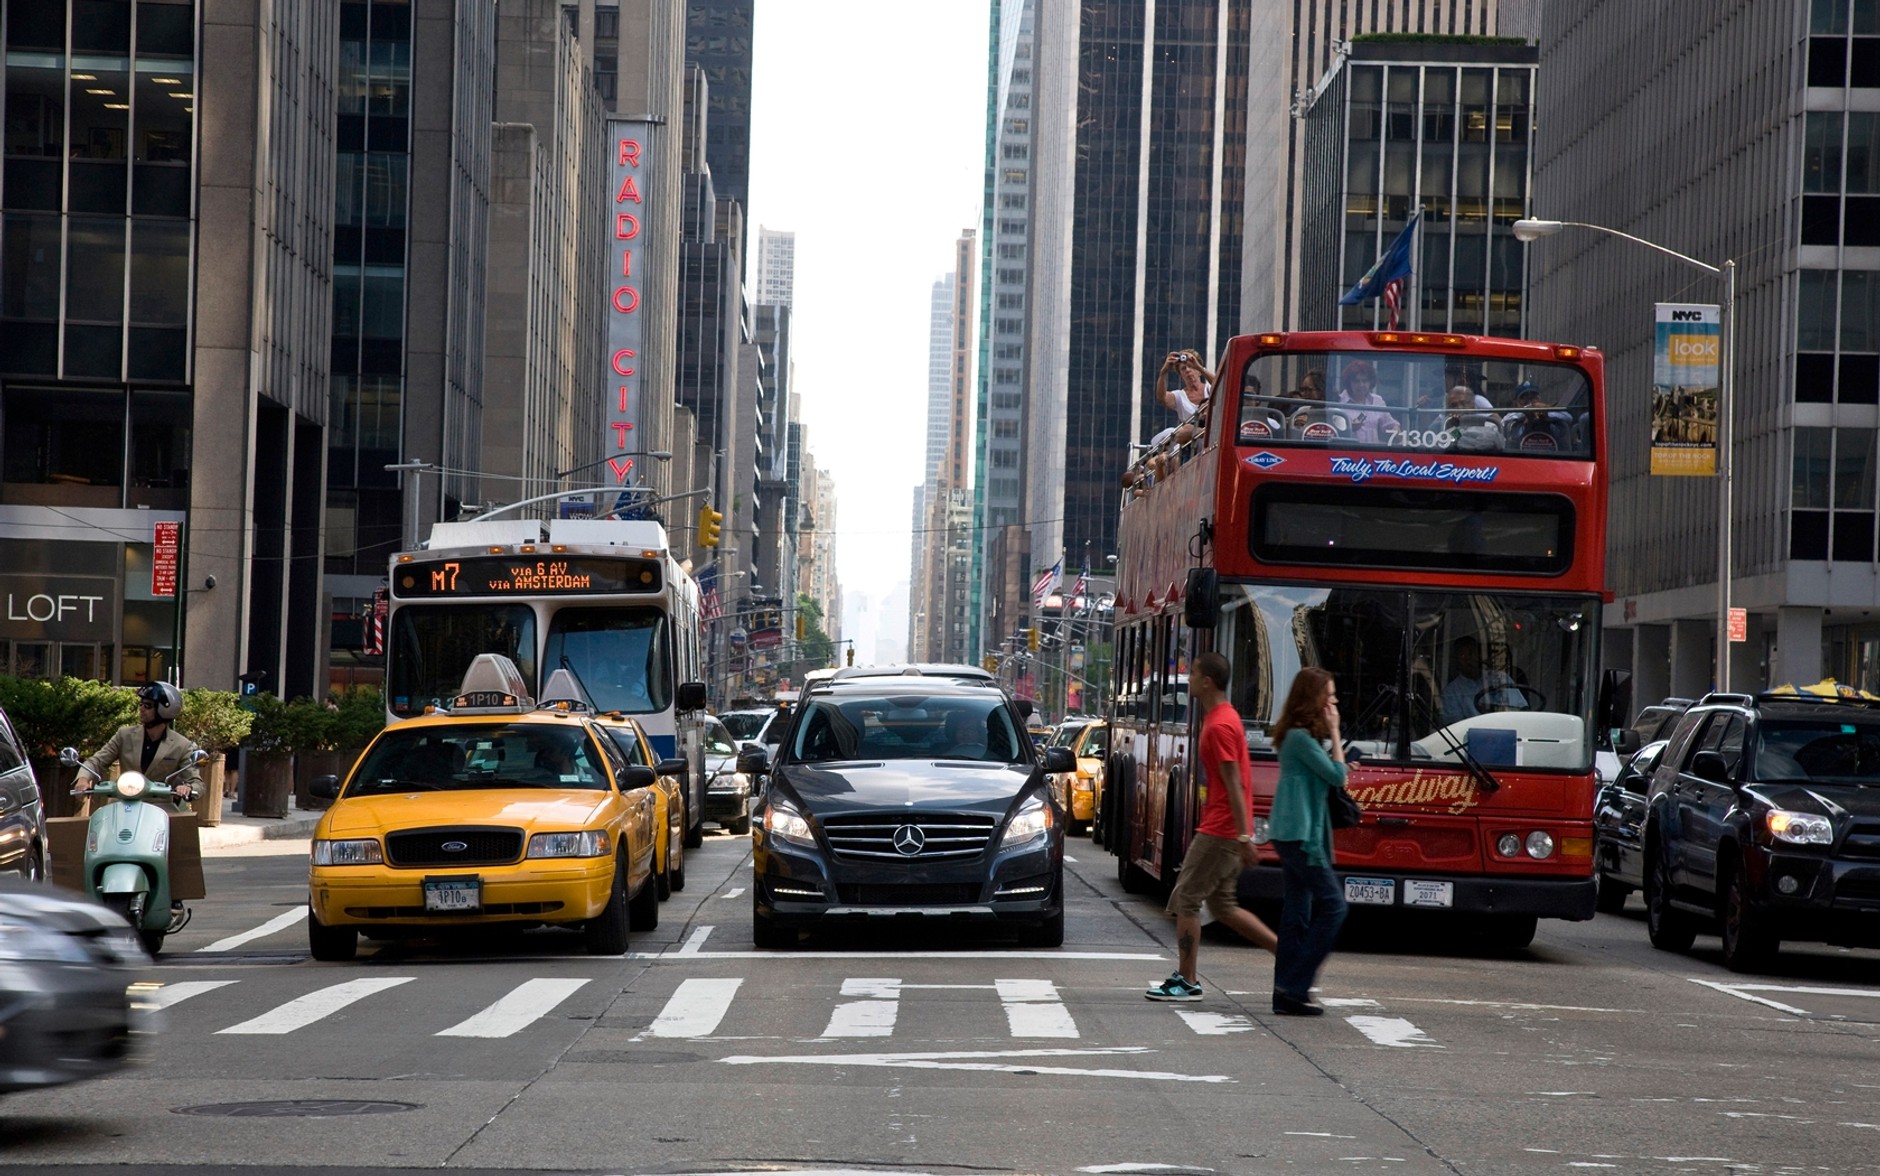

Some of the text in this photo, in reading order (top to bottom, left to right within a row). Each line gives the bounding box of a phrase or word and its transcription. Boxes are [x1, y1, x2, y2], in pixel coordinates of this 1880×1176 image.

[608, 138, 642, 484] RADIO CITY
[1672, 310, 1702, 321] NYC
[1675, 338, 1716, 356] look
[1385, 429, 1452, 449] 71309
[1330, 457, 1499, 483] Truly, The Local Expert!
[432, 563, 460, 590] M7
[511, 562, 567, 576] VIA 6 AV
[489, 575, 590, 590] VIA AMSTERDAM
[8, 593, 103, 622] LOFT
[246, 683, 256, 695] P
[471, 694, 499, 706] 1P10
[1344, 768, 1479, 815] roadway
[1419, 891, 1438, 900] 2071
